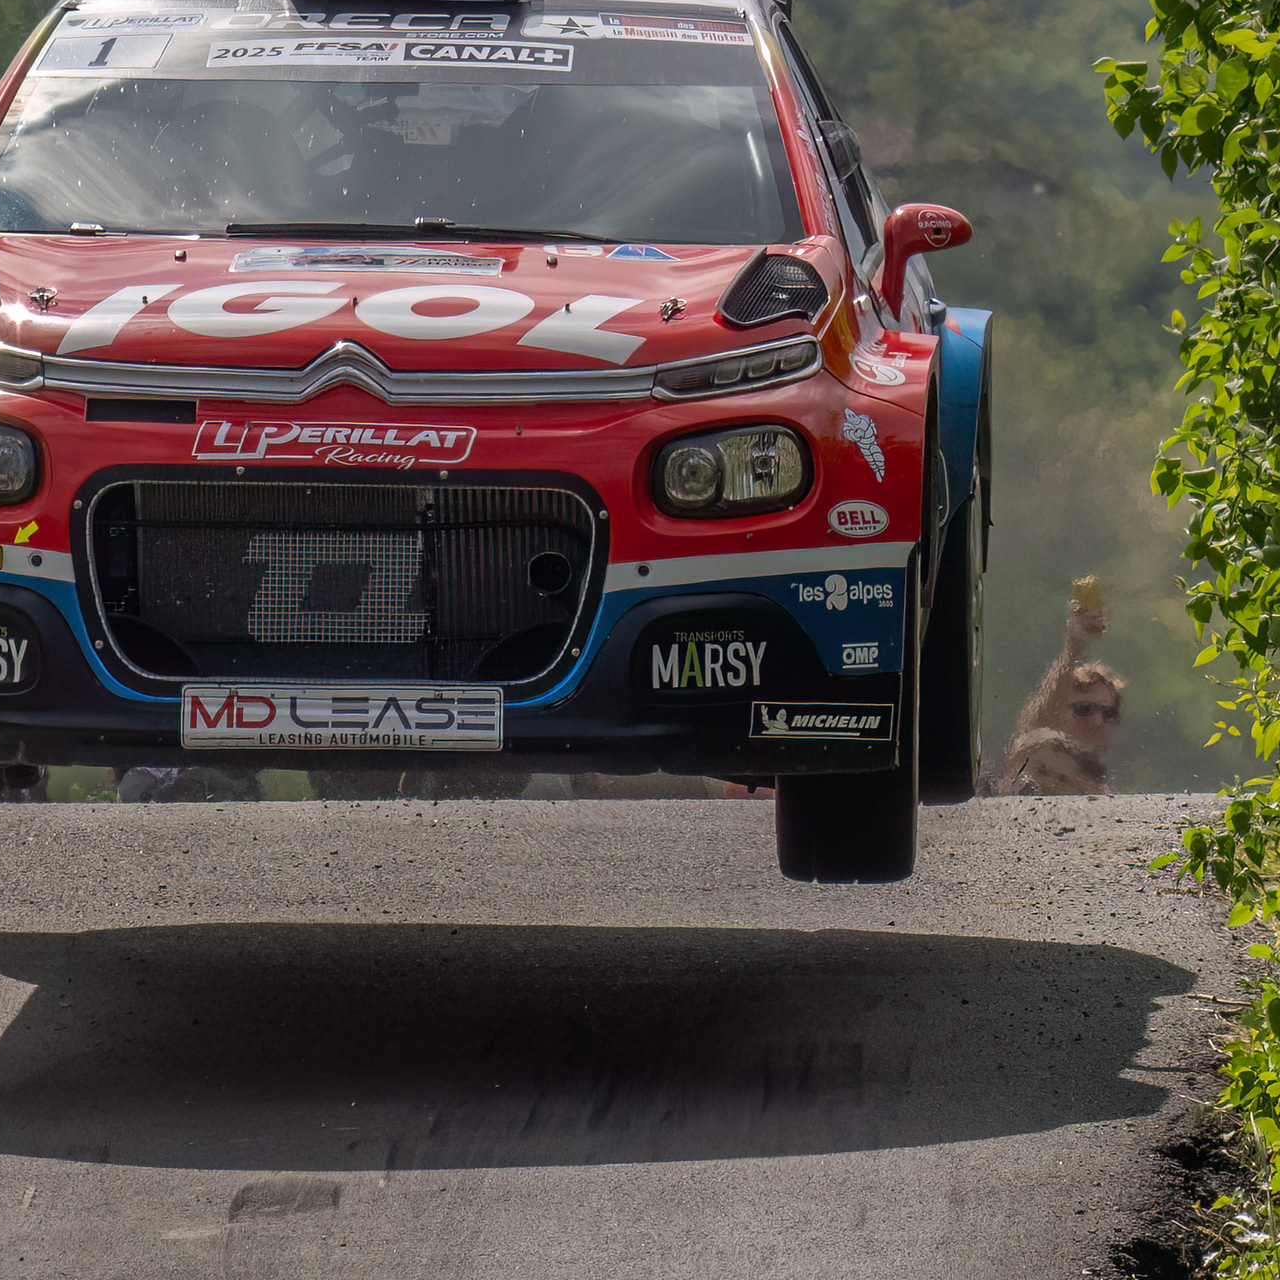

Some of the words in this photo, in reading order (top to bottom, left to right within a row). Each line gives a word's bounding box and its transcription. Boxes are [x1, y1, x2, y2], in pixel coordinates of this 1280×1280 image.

[210, 13, 511, 30] ORECA
[624, 28, 678, 39] Magasin
[701, 32, 745, 42] Pilotes
[88, 37, 117, 67] 1
[213, 46, 285, 60] 2025
[293, 42, 389, 51] FFSA
[411, 45, 563, 63] CANAL+
[918, 220, 952, 229] RACING
[56, 281, 647, 366] IGOL
[315, 445, 417, 470] Racing
[836, 510, 882, 526] BELL
[673, 630, 745, 642] TRANSPORTS
[842, 647, 879, 664] OMP
[652, 641, 767, 689] MARSY
[790, 714, 881, 729] MICHELIN
[259, 733, 322, 745] LEASING
[330, 733, 427, 746] AUTOMOBILE
